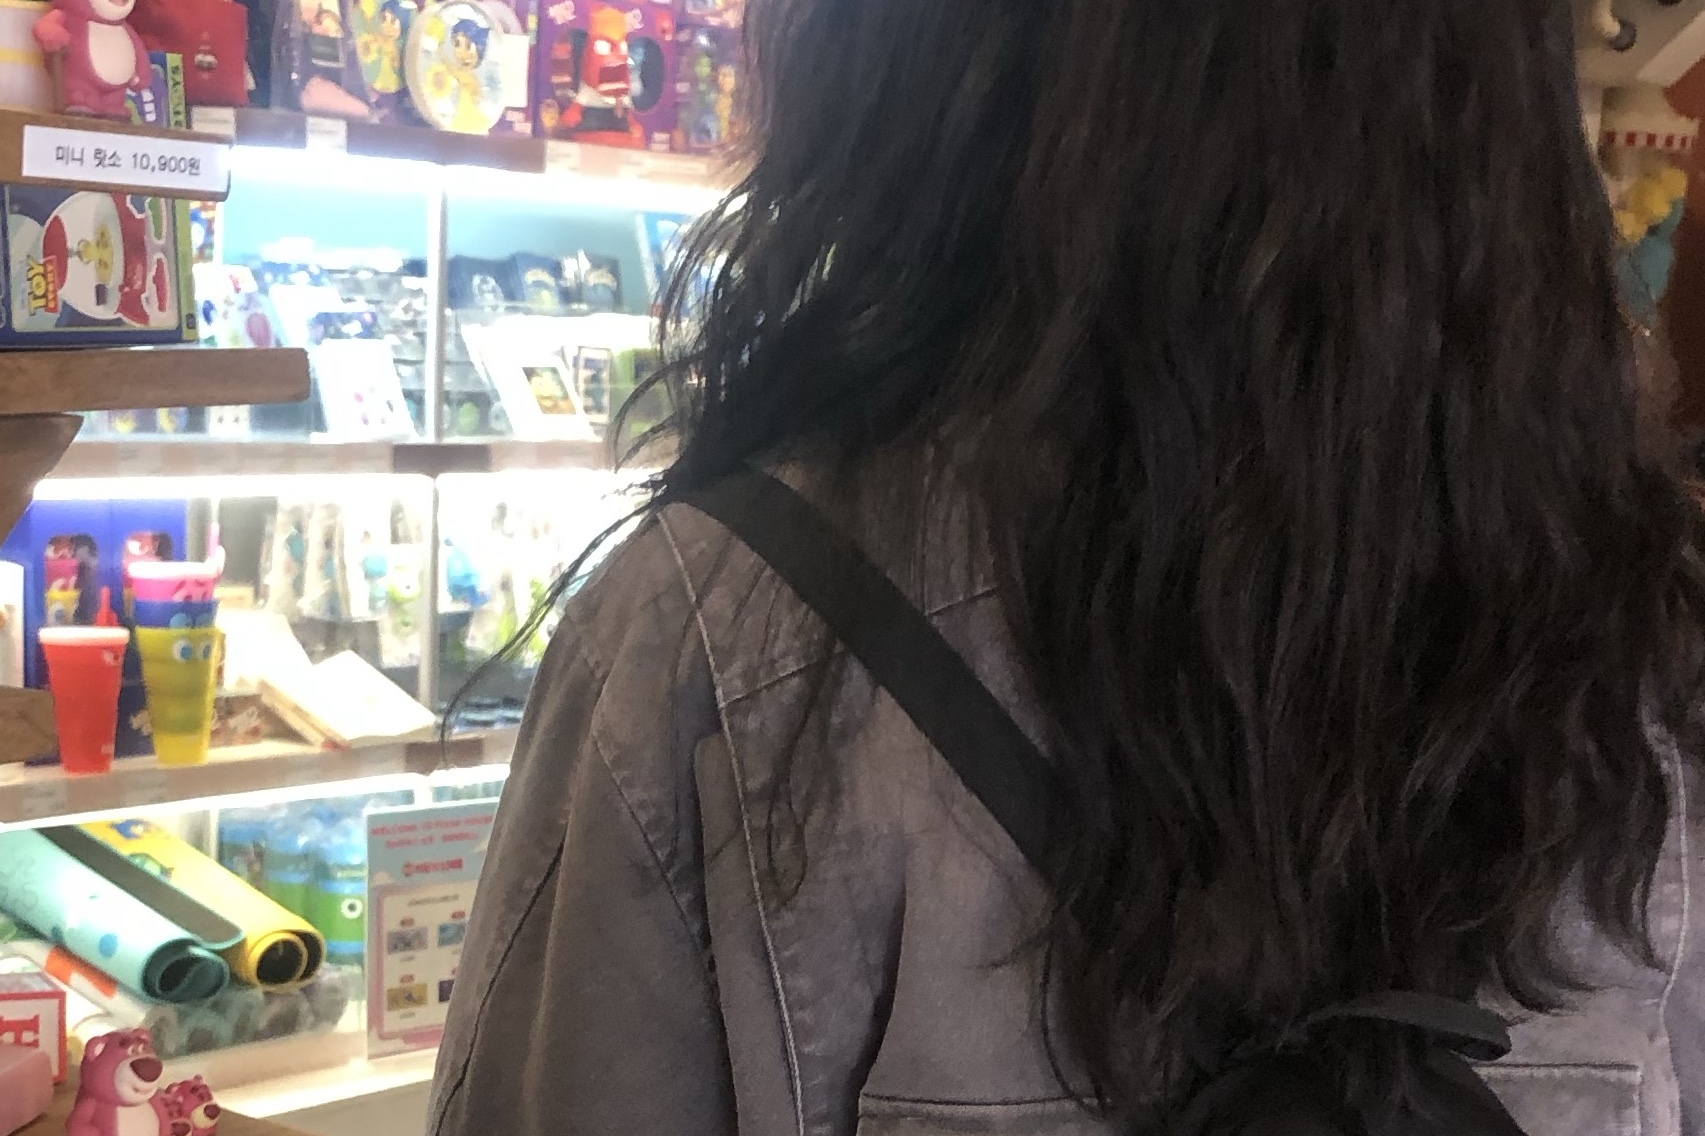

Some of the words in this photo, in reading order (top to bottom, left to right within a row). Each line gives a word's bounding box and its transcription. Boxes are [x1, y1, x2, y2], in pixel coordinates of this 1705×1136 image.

[56, 145, 84, 166] 미니
[131, 152, 201, 176] 10,900원
[27, 254, 47, 316] TOY
